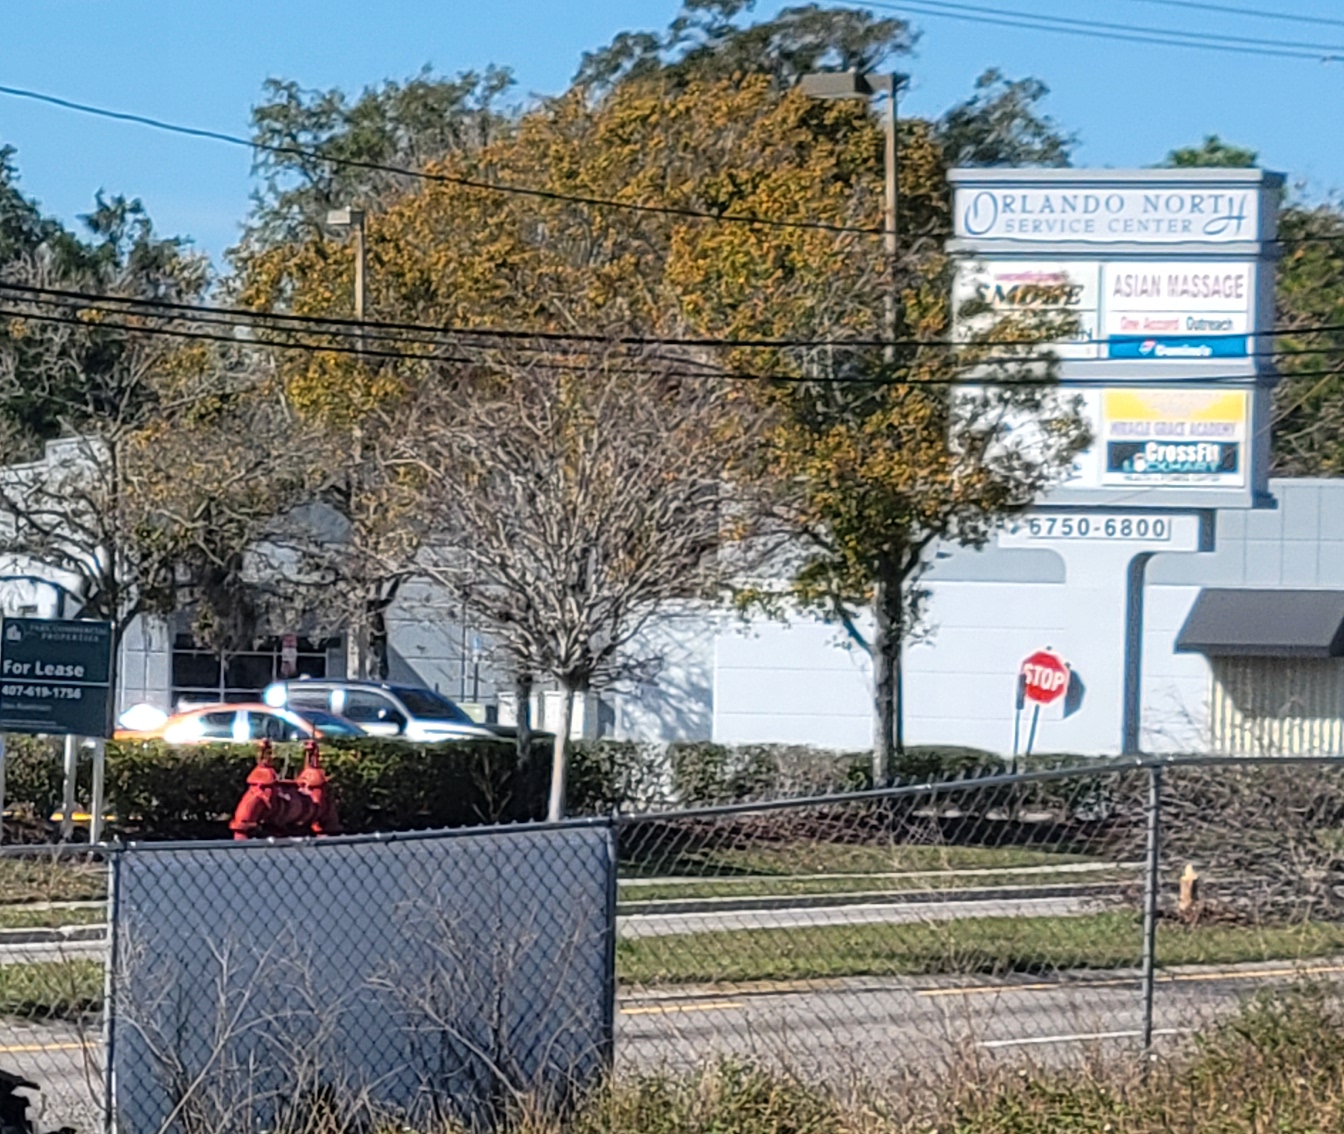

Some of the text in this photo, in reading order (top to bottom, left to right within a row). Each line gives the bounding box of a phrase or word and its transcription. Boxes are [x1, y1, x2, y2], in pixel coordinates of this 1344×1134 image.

[964, 191, 1247, 235] ORLANDO NORTH
[1005, 218, 1192, 233] SERVICE CENTER
[1113, 274, 1244, 299] ASIAN MASSAGE
[1029, 517, 1165, 537] 6750-6800
[3, 659, 85, 677] For Lease
[1024, 663, 1065, 691] STOP
